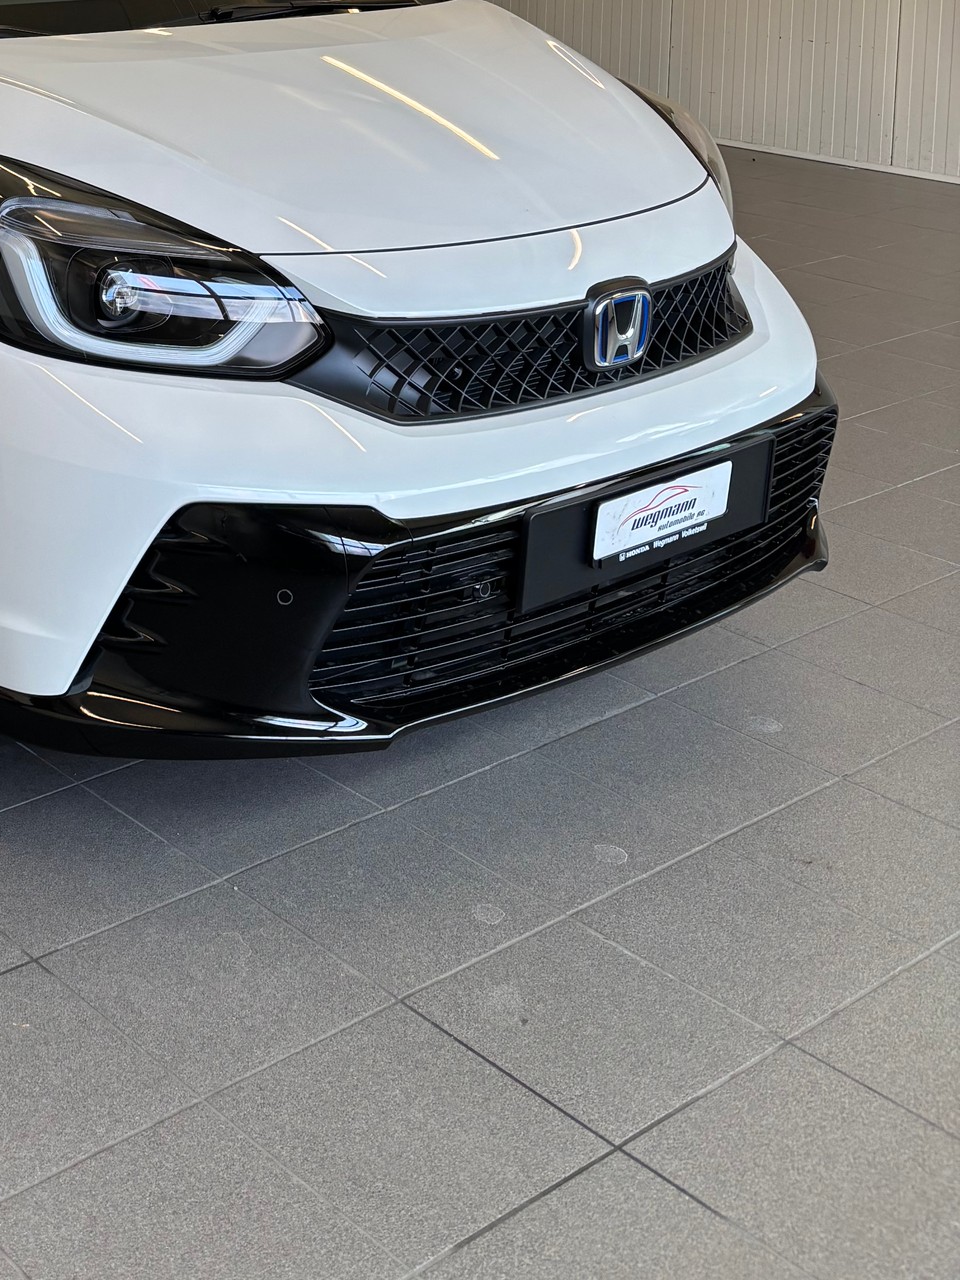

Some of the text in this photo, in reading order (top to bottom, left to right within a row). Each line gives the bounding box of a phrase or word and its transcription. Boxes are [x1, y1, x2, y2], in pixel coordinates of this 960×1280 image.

[631, 498, 697, 531] wegmann
[626, 545, 650, 558] HONDA
[653, 534, 680, 549] Wegmann
